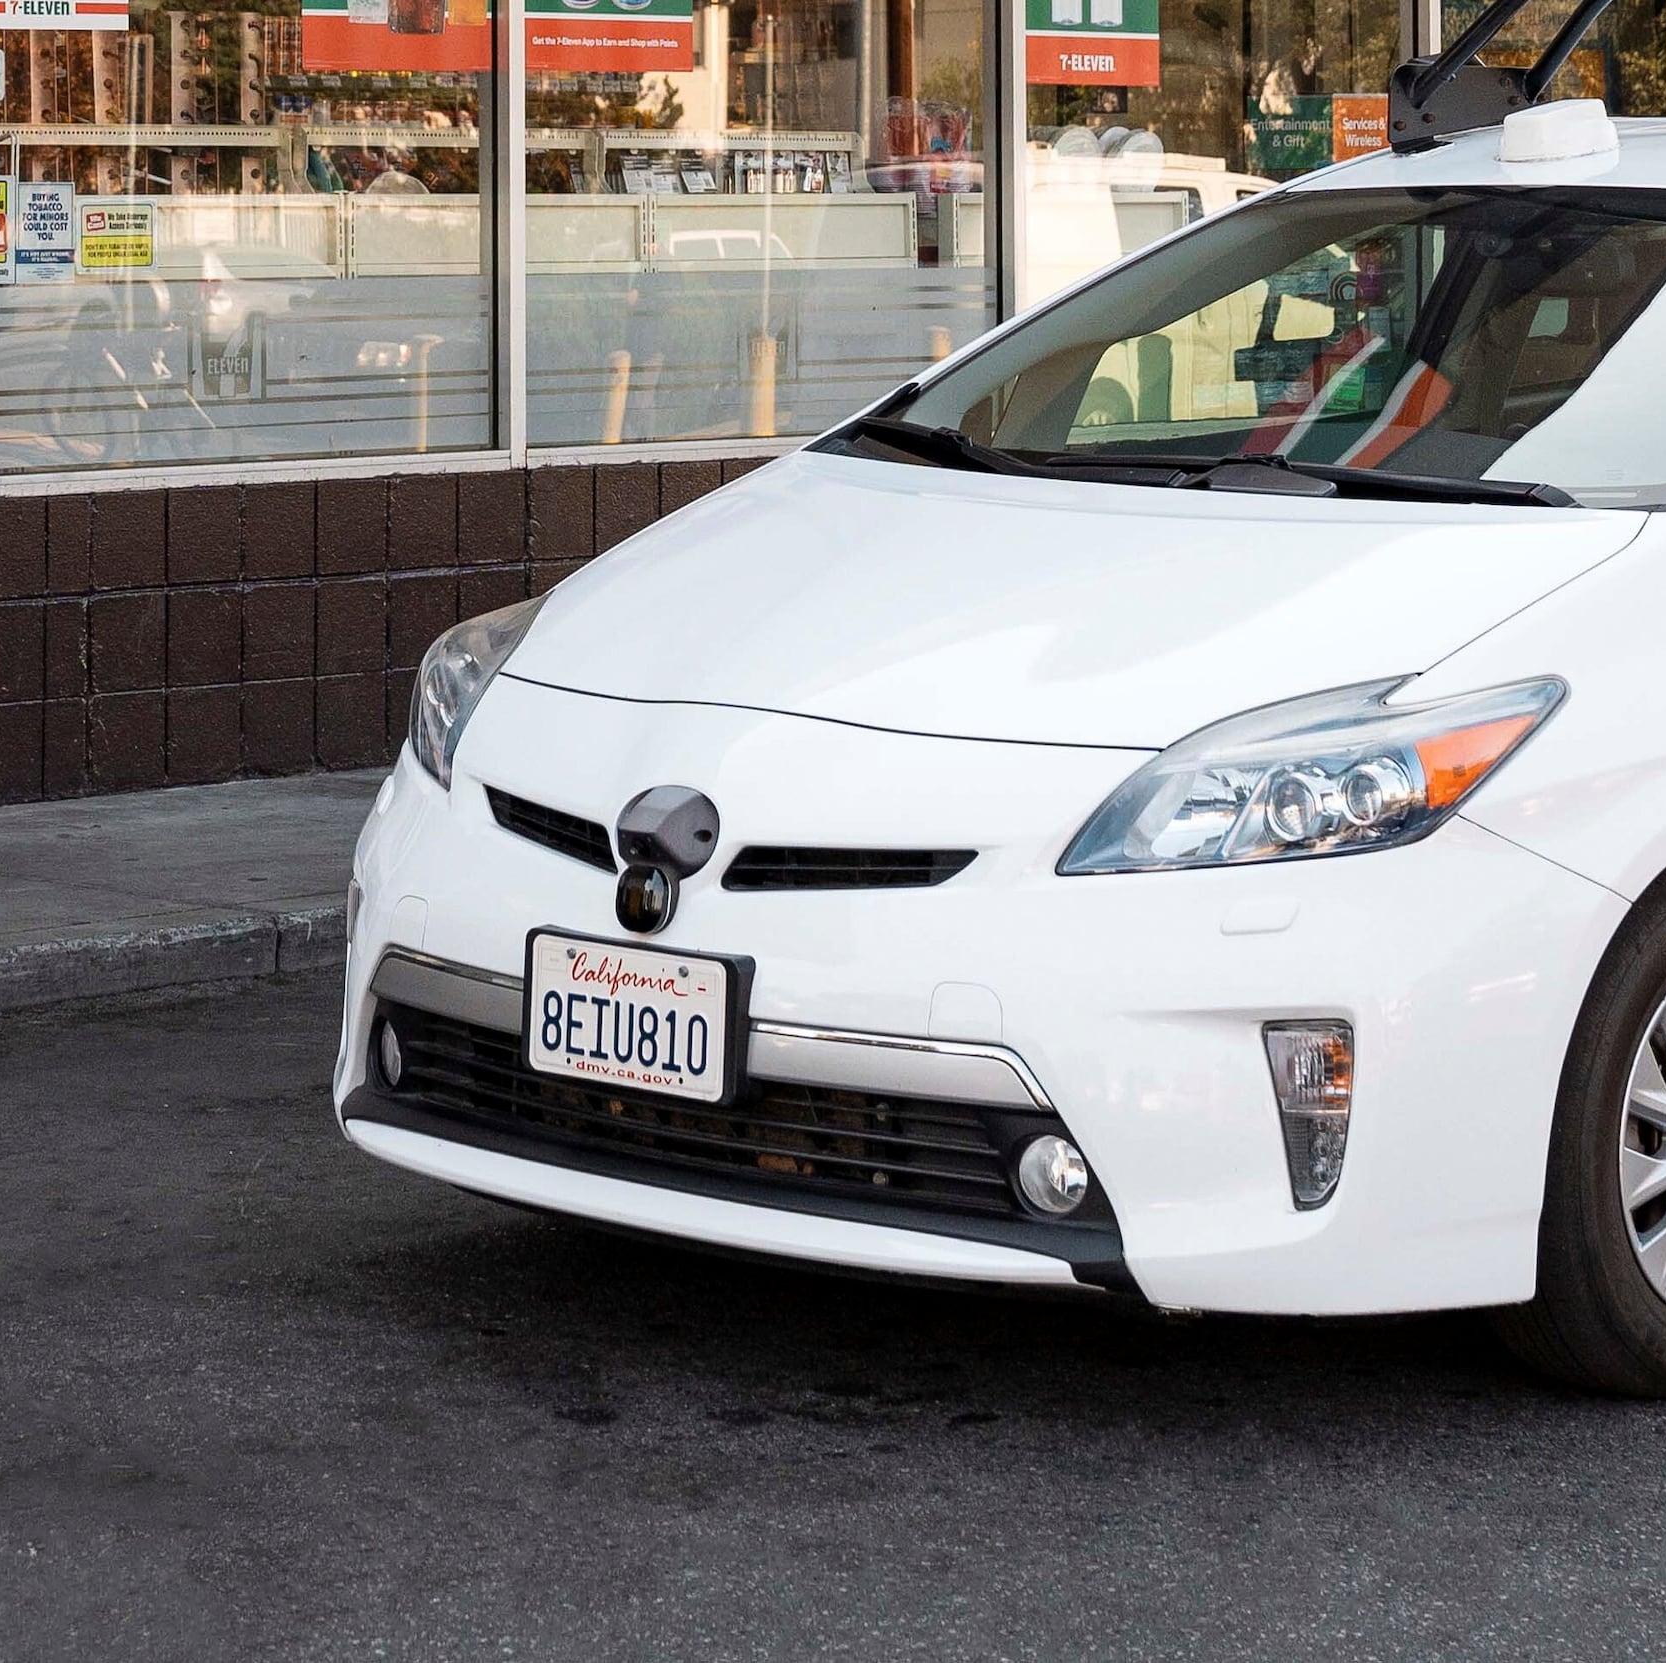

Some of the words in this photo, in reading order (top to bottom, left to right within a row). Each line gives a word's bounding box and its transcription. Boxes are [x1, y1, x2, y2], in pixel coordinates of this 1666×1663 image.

[1251, 118, 1331, 132] Entertainment
[1342, 117, 1377, 131] Services
[1273, 136, 1281, 147] &
[1284, 135, 1305, 147] Gift
[1345, 135, 1382, 147] Wireless
[32, 193, 59, 202] BUYING
[28, 203, 62, 211] TOBACCO
[23, 213, 38, 221] FOR
[40, 213, 68, 221] MINORS
[24, 223, 48, 231] COULD
[50, 223, 68, 231] COST
[571, 951, 689, 997] California
[541, 990, 708, 1076] 8EIU810
[576, 1060, 673, 1086] dmv.ca.gov
